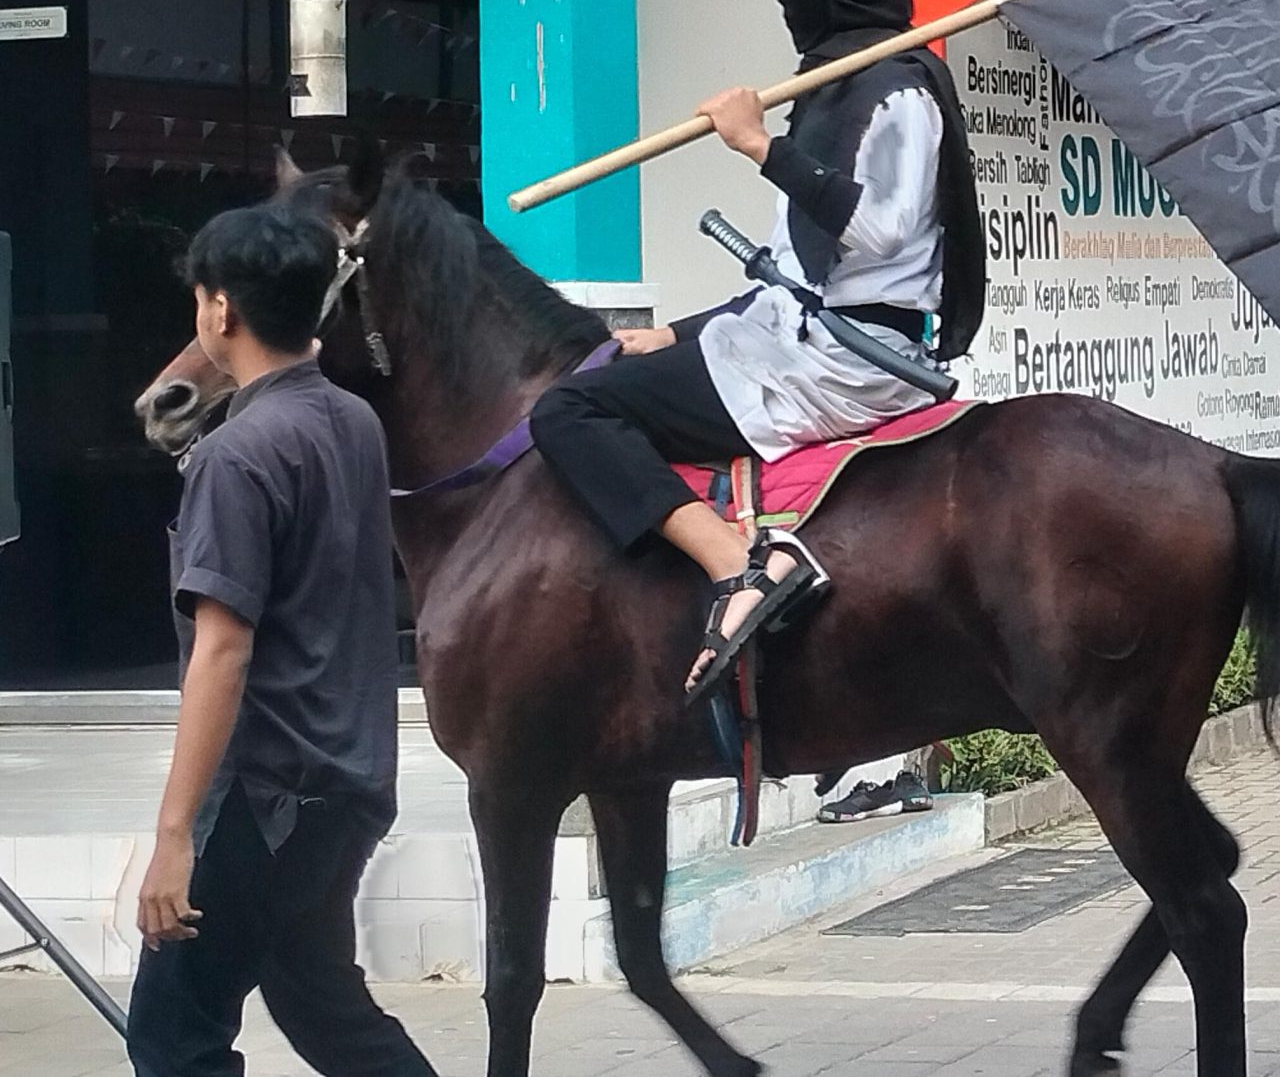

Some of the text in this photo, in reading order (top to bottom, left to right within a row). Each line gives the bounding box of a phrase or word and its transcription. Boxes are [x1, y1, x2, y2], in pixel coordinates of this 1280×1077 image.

[968, 55, 1036, 107] Bersinergi
[986, 106, 1036, 146] Menolong
[968, 149, 1007, 184] Bersih
[1015, 155, 1051, 192] Tabligh
[1060, 134, 1102, 216] SD
[981, 193, 1060, 277] isiplin
[1144, 233, 1161, 259] dan
[985, 278, 1028, 315] Tangguh
[1034, 278, 1100, 320] Kerja Keras
[1106, 275, 1141, 310] Religius
[1144, 275, 1181, 314] Empati
[1192, 275, 1235, 301] Demokratis
[1014, 318, 1219, 400] Bertanggung Jawab
[1222, 350, 1267, 379] Cinta Damai
[1197, 388, 1254, 420] Gotong Royong
